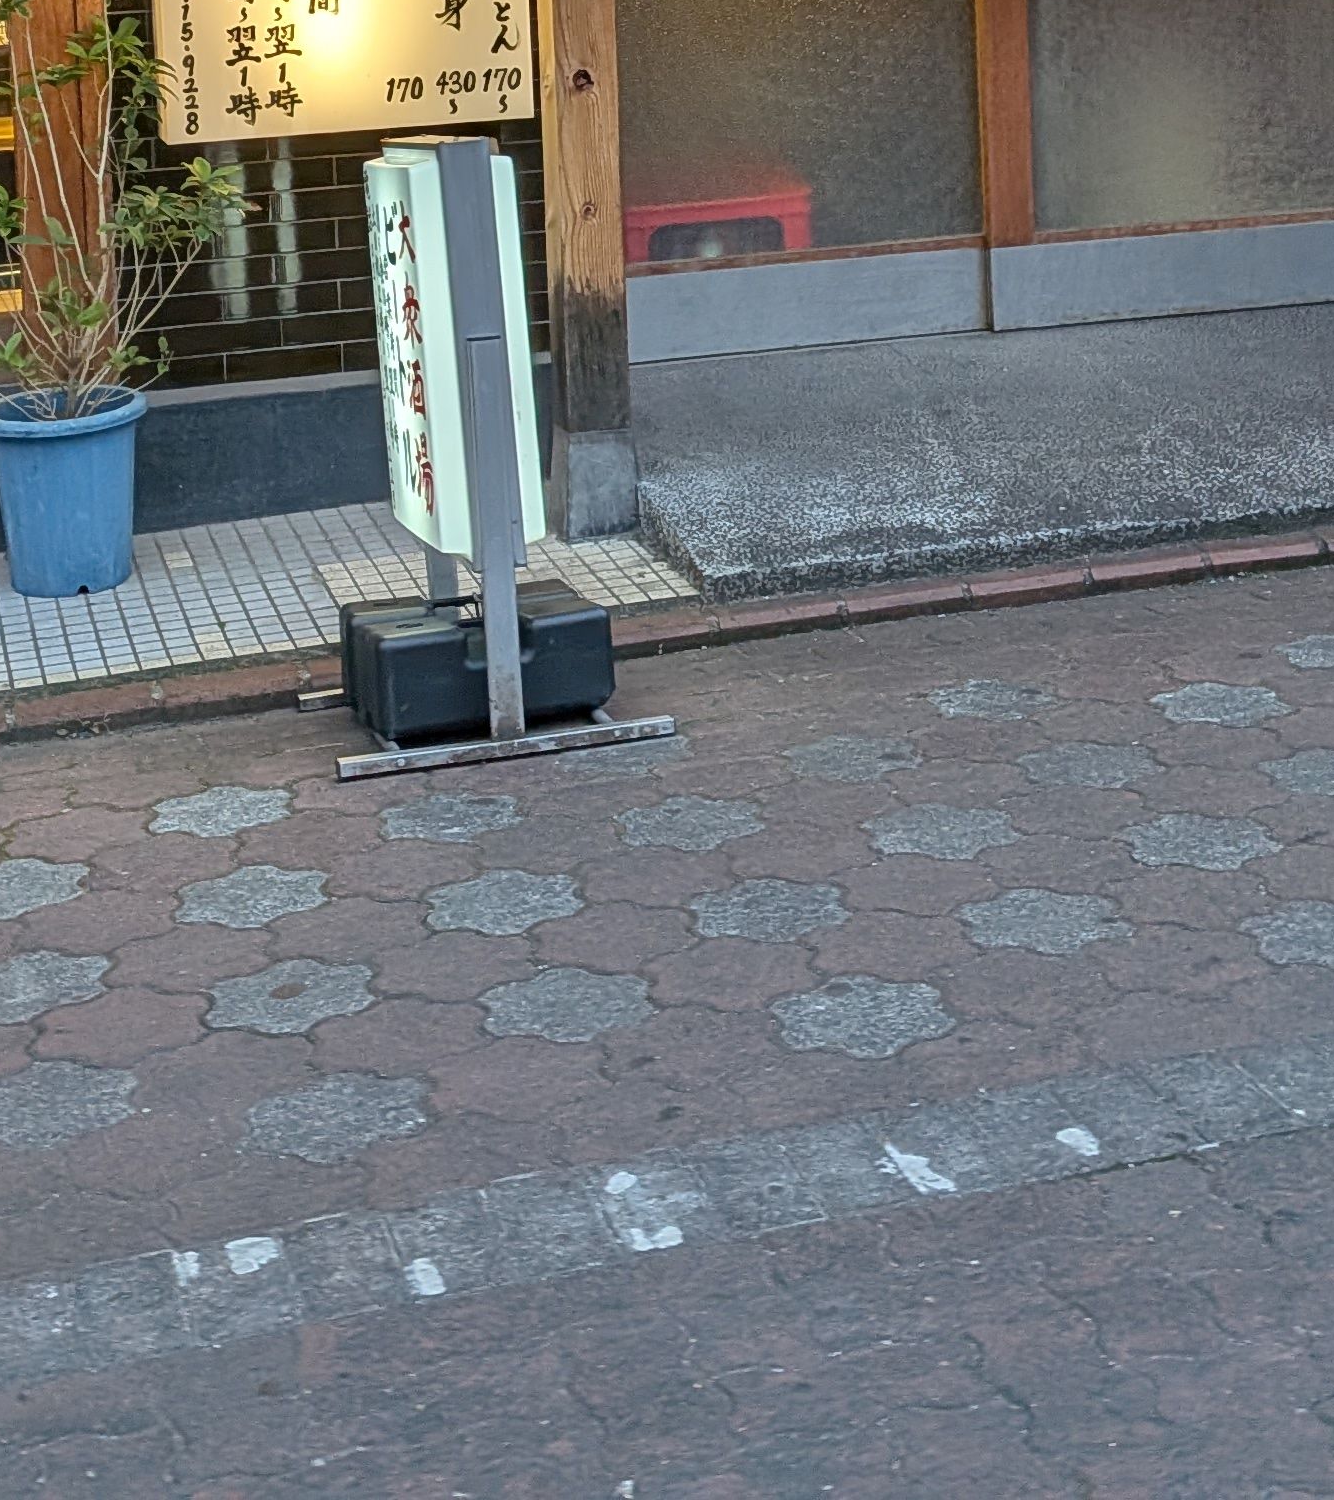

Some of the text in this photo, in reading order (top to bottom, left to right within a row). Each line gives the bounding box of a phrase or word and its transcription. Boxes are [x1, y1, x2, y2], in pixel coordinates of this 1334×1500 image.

[386, 77, 423, 102] 170
[398, 200, 434, 517] 大衆酒場
